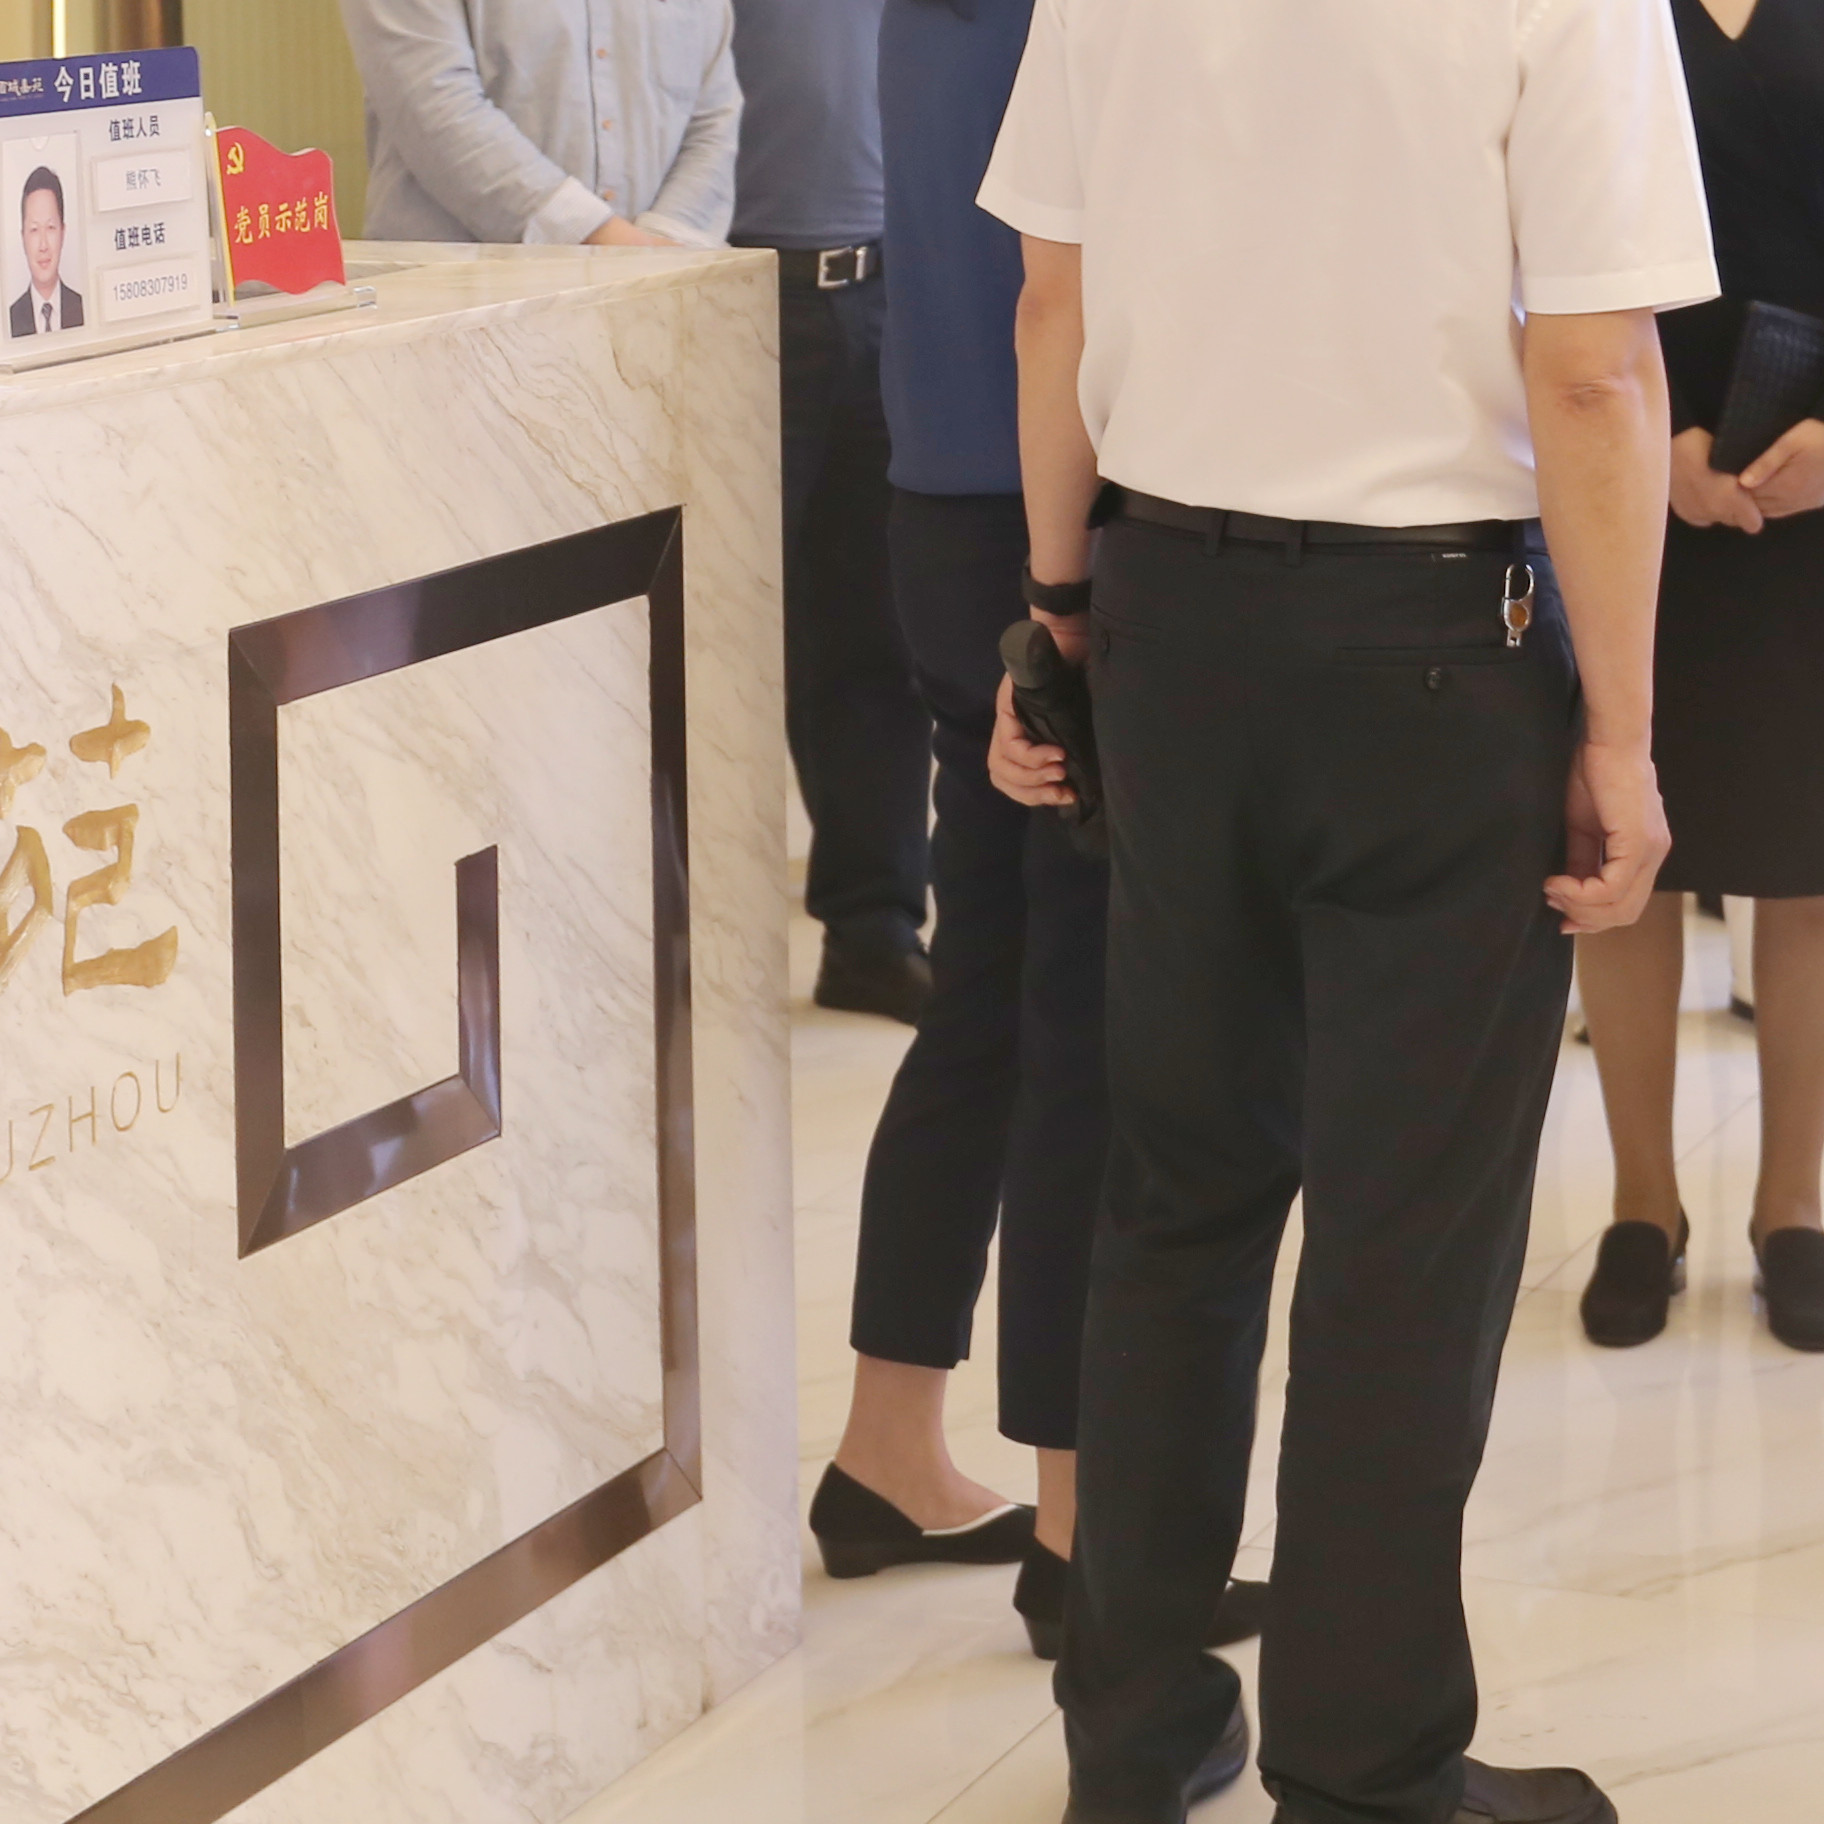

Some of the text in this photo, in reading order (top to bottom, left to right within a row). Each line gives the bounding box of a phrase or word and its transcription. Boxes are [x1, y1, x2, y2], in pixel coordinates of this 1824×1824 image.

[54, 60, 143, 103] 今日值班
[108, 115, 160, 142] 值班人员
[234, 191, 329, 244] 党员示范岗
[114, 222, 166, 251] 值班电话
